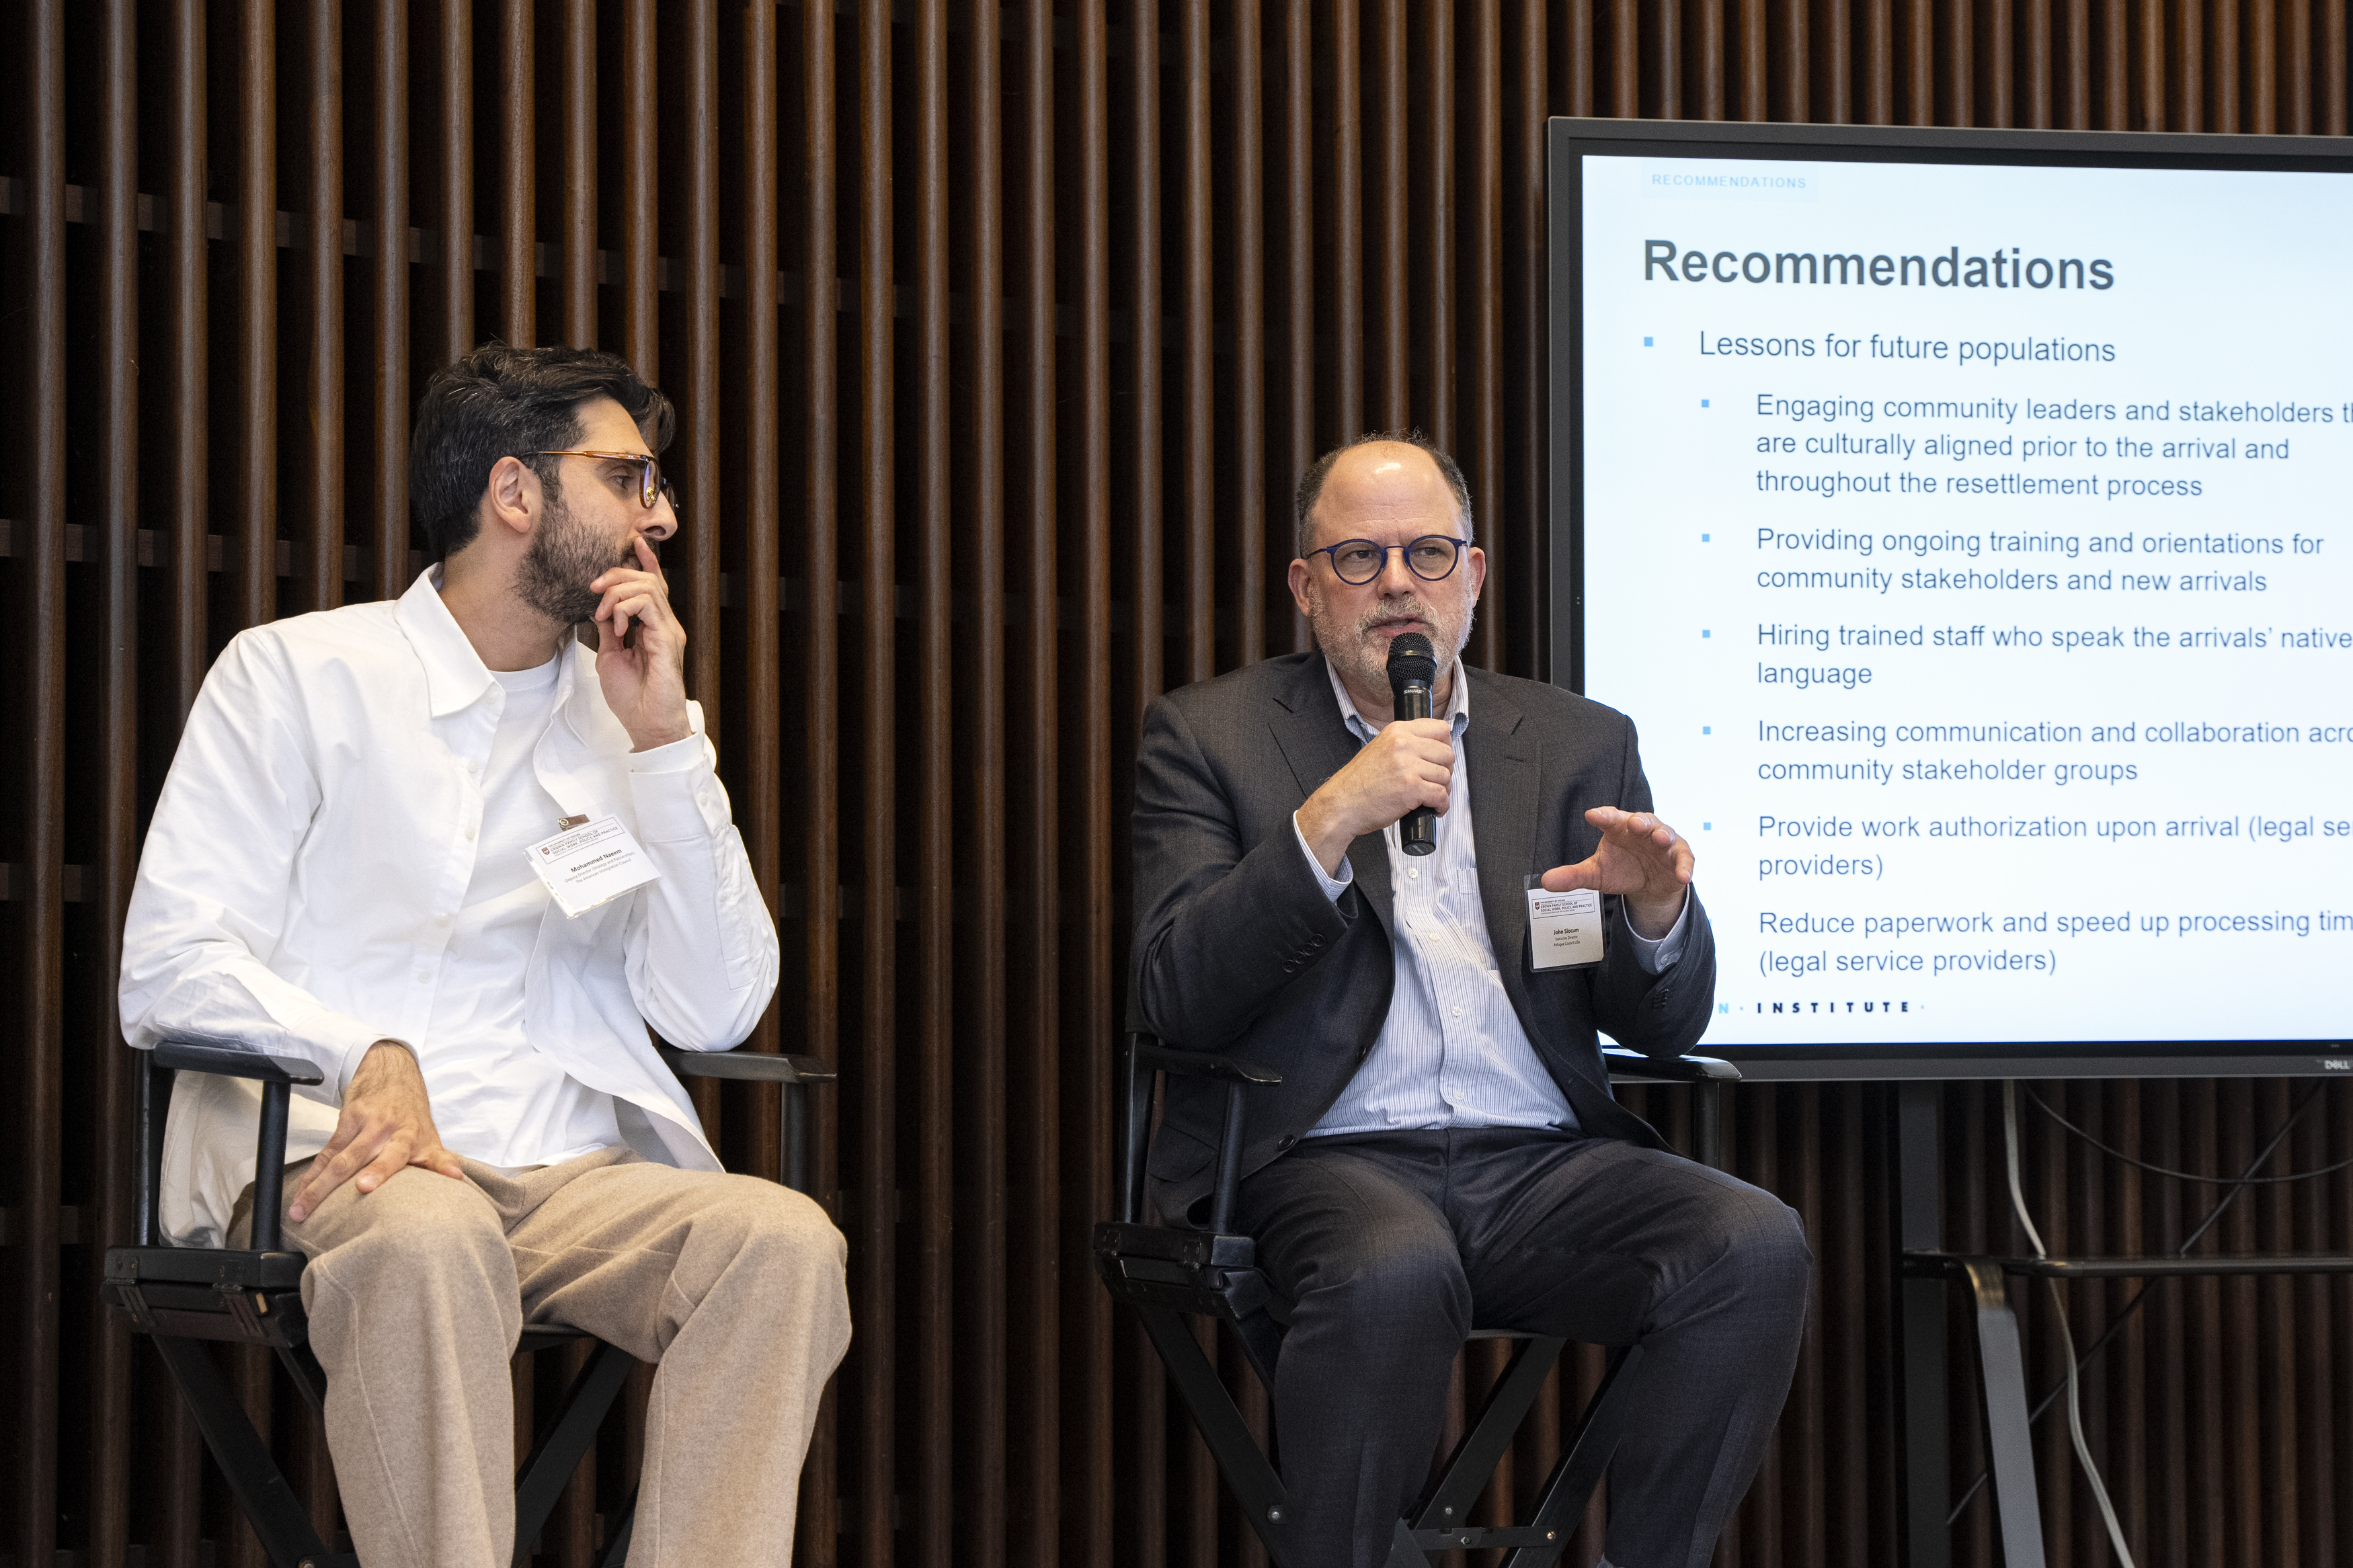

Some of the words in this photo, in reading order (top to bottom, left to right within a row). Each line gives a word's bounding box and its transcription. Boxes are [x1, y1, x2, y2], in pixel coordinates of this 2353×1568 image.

[1651, 173, 1806, 189] RECOMMENDATIONS
[1644, 239, 2115, 290] Recommendations
[1700, 331, 1816, 357] Lessons
[1825, 333, 1862, 358] for
[1870, 333, 1949, 359] future
[1959, 337, 2116, 367] populations
[1758, 394, 1873, 422] Engaging
[1884, 397, 2018, 424] community
[2028, 398, 2116, 419] leaders
[2126, 400, 2169, 420] and
[2180, 401, 2334, 423] stakeholders
[1757, 437, 1796, 452] are
[1806, 432, 1915, 460] culturally
[1925, 434, 2012, 461] aligned
[2023, 435, 2077, 462] prior
[2085, 437, 2107, 456] to
[2116, 436, 2153, 457] the
[2163, 438, 2235, 458] arrival
[2245, 438, 2288, 459] and
[1757, 470, 1890, 497] throughout
[1899, 471, 1937, 492] the
[1947, 473, 2099, 495] resettlement
[2108, 479, 2202, 500] process
[1758, 528, 1872, 556] Providing
[1882, 530, 1980, 556] ongoing
[1990, 530, 2079, 558] training
[2089, 531, 2132, 552] and
[2143, 532, 2284, 553] orientations
[2292, 533, 2324, 554] for
[1757, 567, 1892, 594] community
[1902, 568, 2058, 589] stakeholders
[2068, 569, 2111, 589] and
[2122, 574, 2171, 590] new
[2180, 570, 2267, 591] arrivals
[1759, 624, 1829, 651] Hiring
[1839, 624, 1923, 645] trained
[1933, 624, 1985, 645] staff
[1993, 626, 2042, 646] who
[2052, 626, 2124, 652] speak
[2133, 626, 2170, 647] the
[2180, 626, 2272, 647] arrivals’
[2282, 627, 2352, 647] native
[1759, 662, 1872, 689] language
[1759, 720, 1886, 747] Increasing
[1897, 721, 2081, 741] communication
[2091, 721, 2135, 741] and
[2145, 721, 2299, 742] collaboration
[1759, 758, 1893, 785] community
[1903, 758, 2046, 780] stakeholder
[2055, 764, 2137, 786] groups
[1760, 816, 1852, 837] Provide
[1862, 816, 1920, 837] work
[1929, 816, 2086, 836] authorization
[2098, 821, 2155, 842] upon
[2166, 816, 2239, 836] arrival
[2249, 816, 2313, 842] (legal
[2323, 821, 2353, 836] se
[551, 843, 565, 852] CROWN
[570, 856, 603, 872] Mohammed
[602, 850, 622, 859] Naeem
[583, 872, 599, 880] American
[598, 863, 619, 873] Immigration
[1759, 854, 1882, 881] providers)
[1760, 912, 1854, 932] Reduce
[1866, 911, 1993, 938] paperwork
[2003, 911, 2046, 932] and
[2057, 911, 2130, 938] speed
[2141, 915, 2169, 937] up
[2180, 911, 2309, 937] processing
[1760, 950, 1826, 977] (legal
[1837, 950, 1923, 971] service
[1934, 949, 2056, 976] providers)
[1757, 1002, 1909, 1014] INSTITUTE
[2324, 1060, 2350, 1070] DELL
